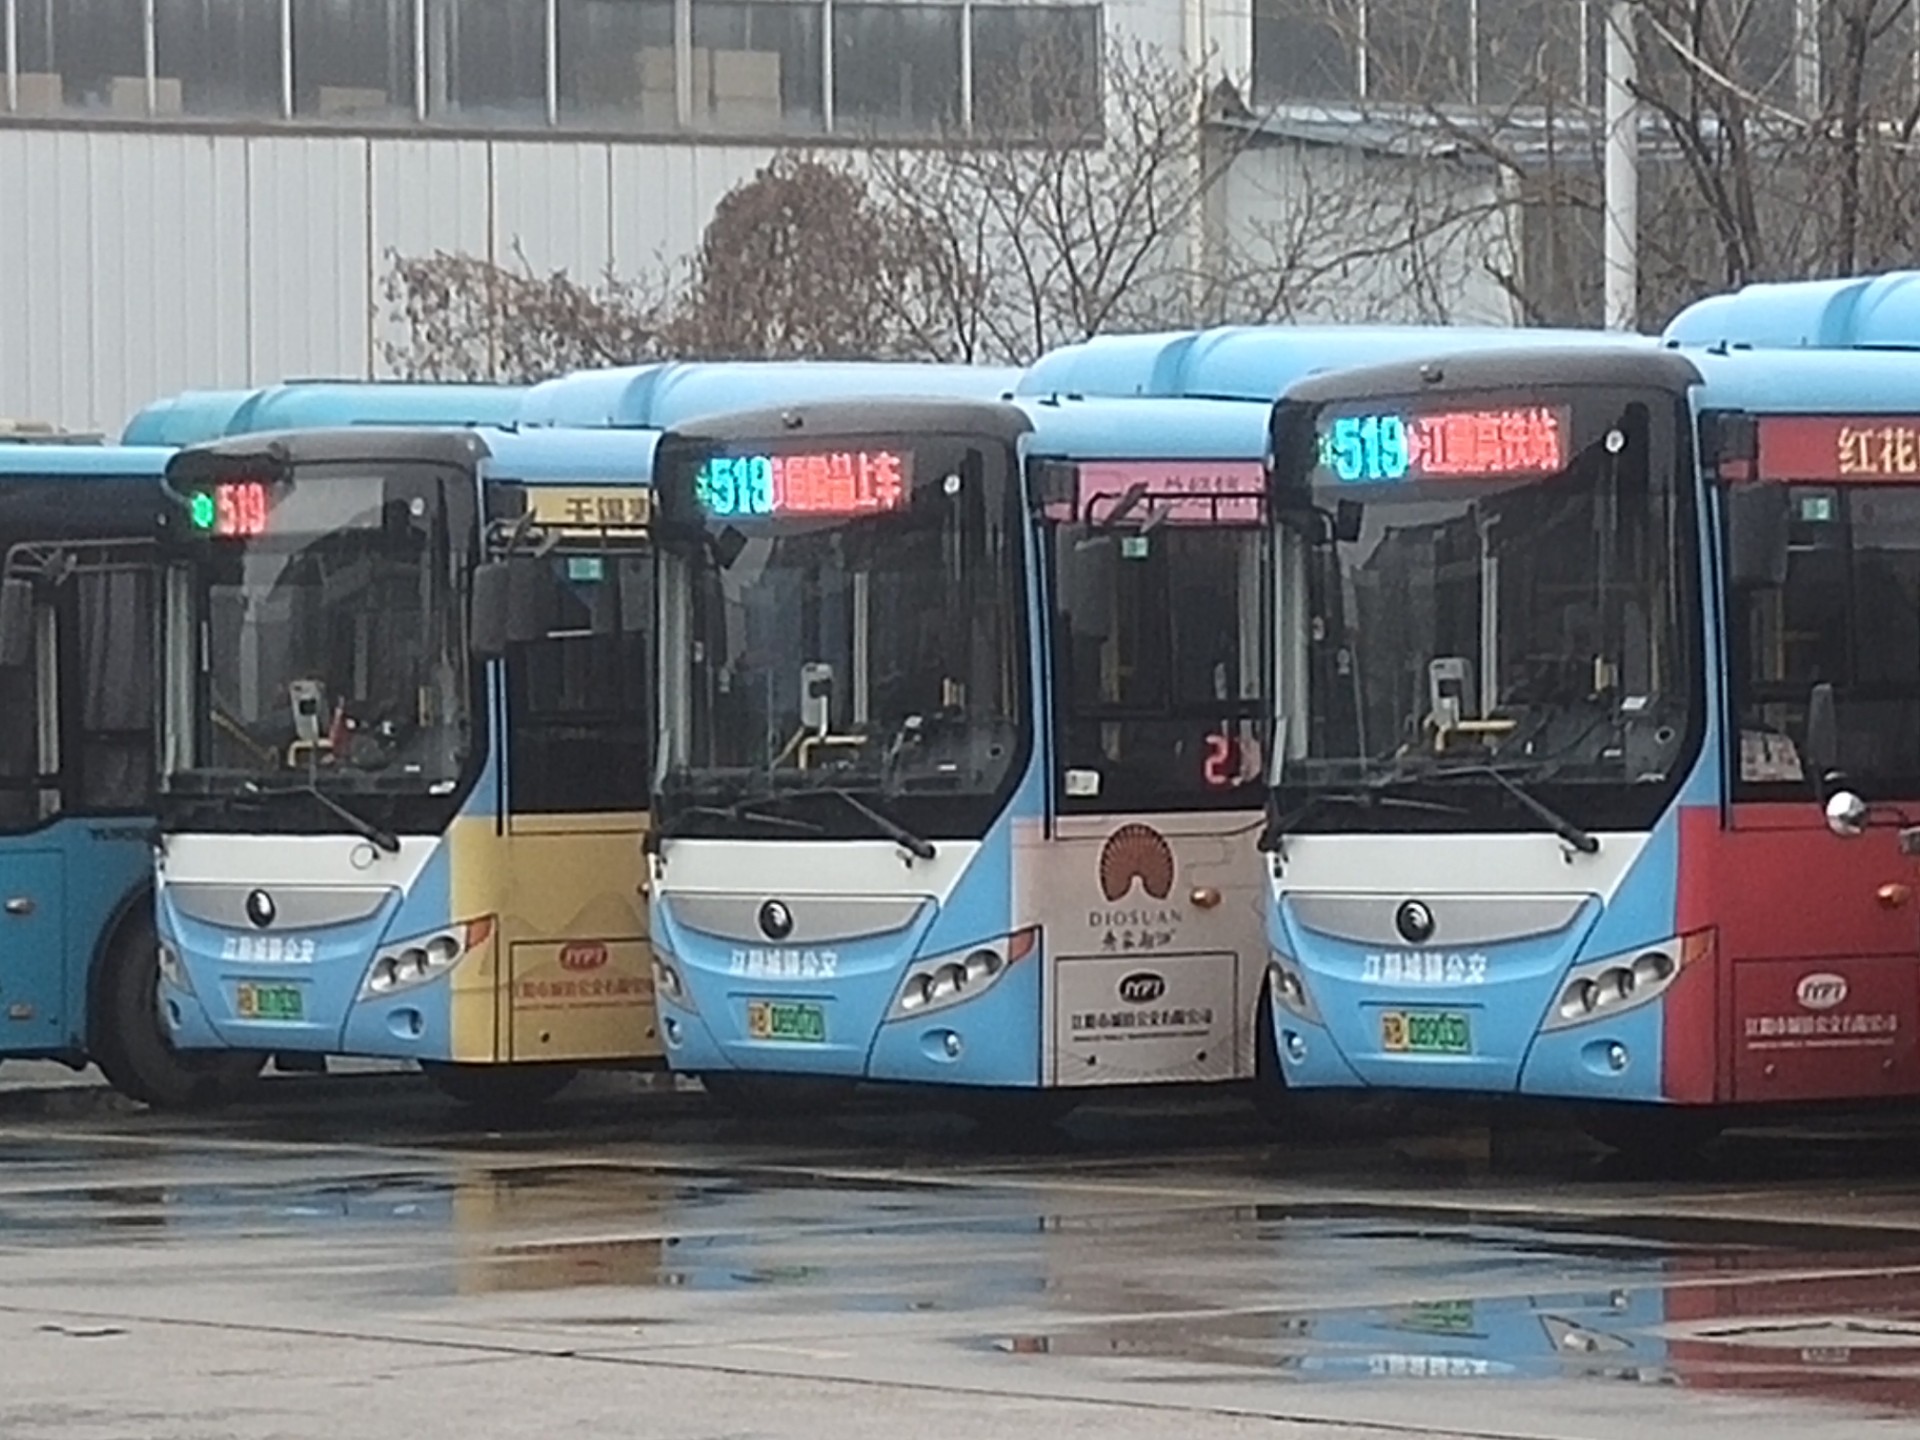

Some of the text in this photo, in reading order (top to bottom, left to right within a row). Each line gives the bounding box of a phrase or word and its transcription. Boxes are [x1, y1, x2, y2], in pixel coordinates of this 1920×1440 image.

[1334, 415, 1408, 480] 519
[1838, 426, 1920, 474] 红花
[217, 482, 265, 535] 519
[711, 456, 774, 514] 519
